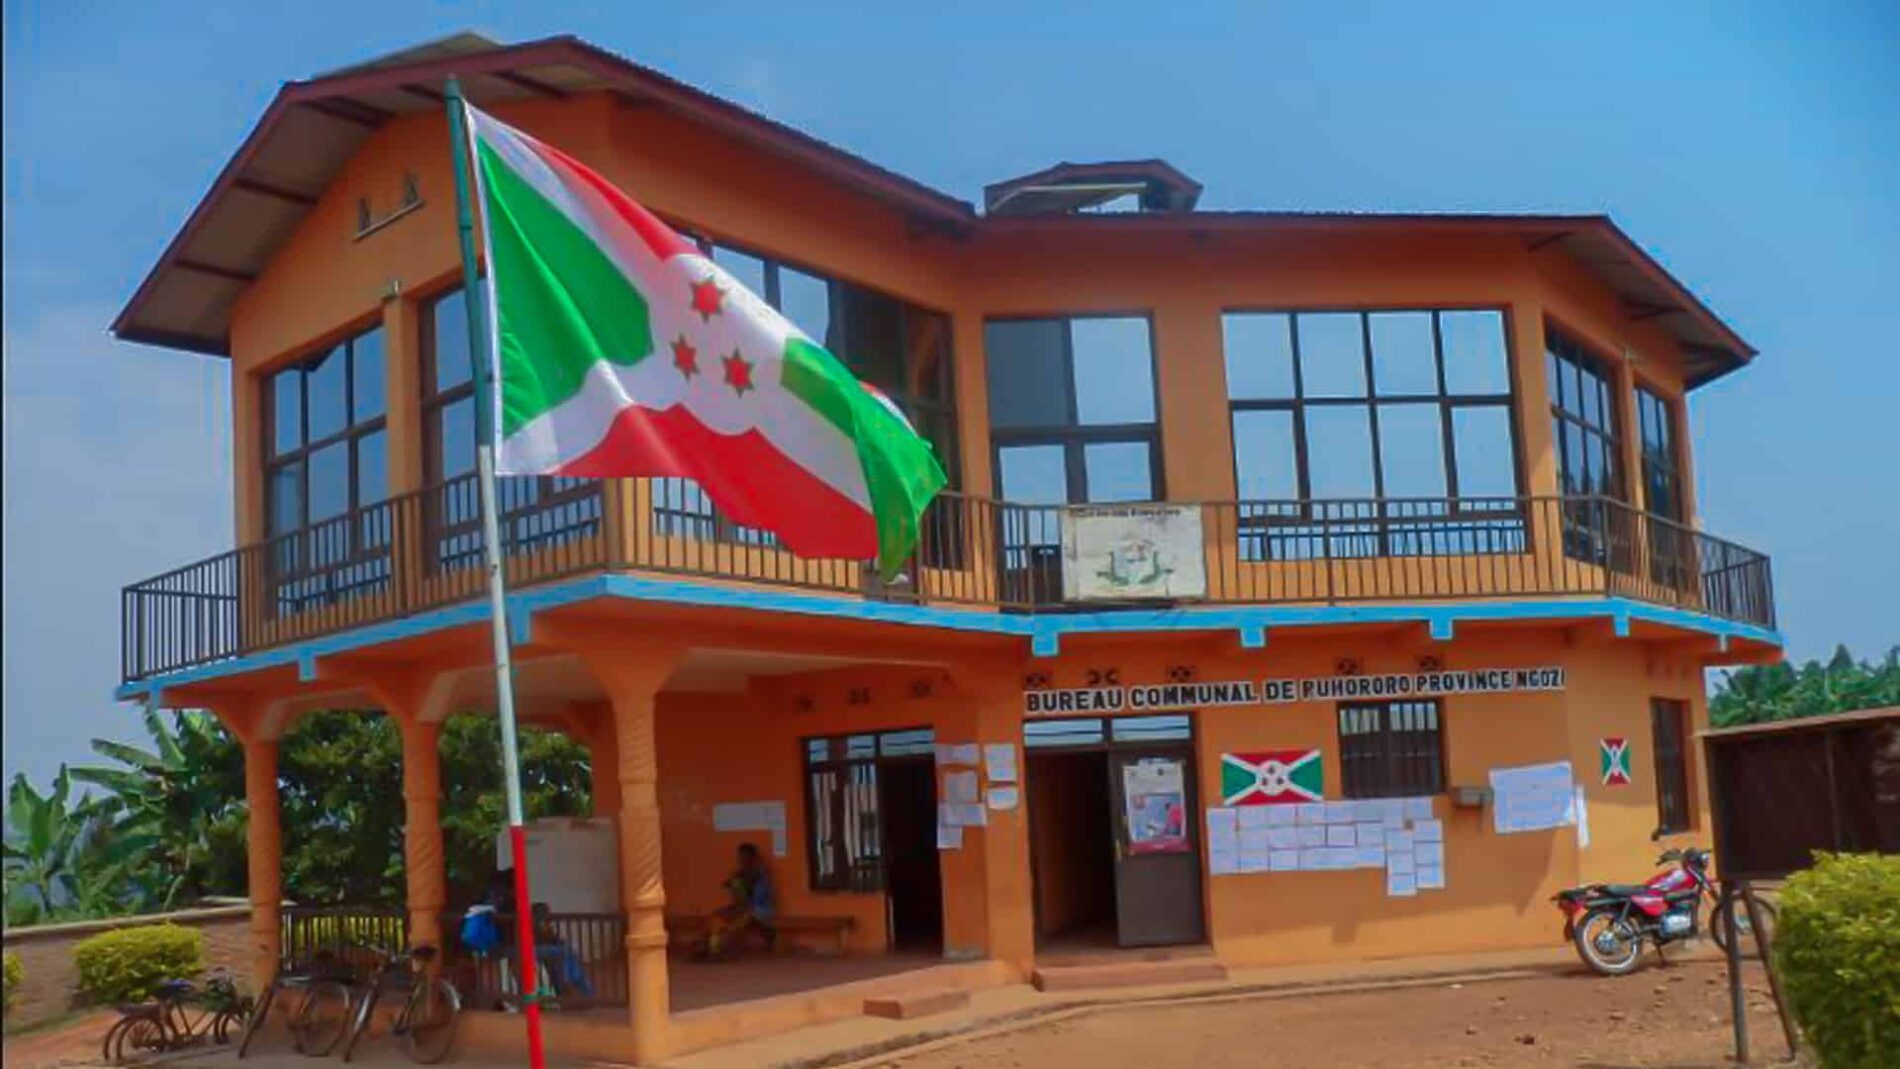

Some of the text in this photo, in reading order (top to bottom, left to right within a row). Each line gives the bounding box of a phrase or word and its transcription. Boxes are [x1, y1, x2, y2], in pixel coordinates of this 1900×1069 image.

[1026, 690, 1123, 712] BUREAU
[1131, 683, 1258, 707] COMMUNAL
[1265, 680, 1295, 700] DE
[1416, 671, 1511, 692] PROVINCE
[1517, 669, 1565, 687] NGOZI
